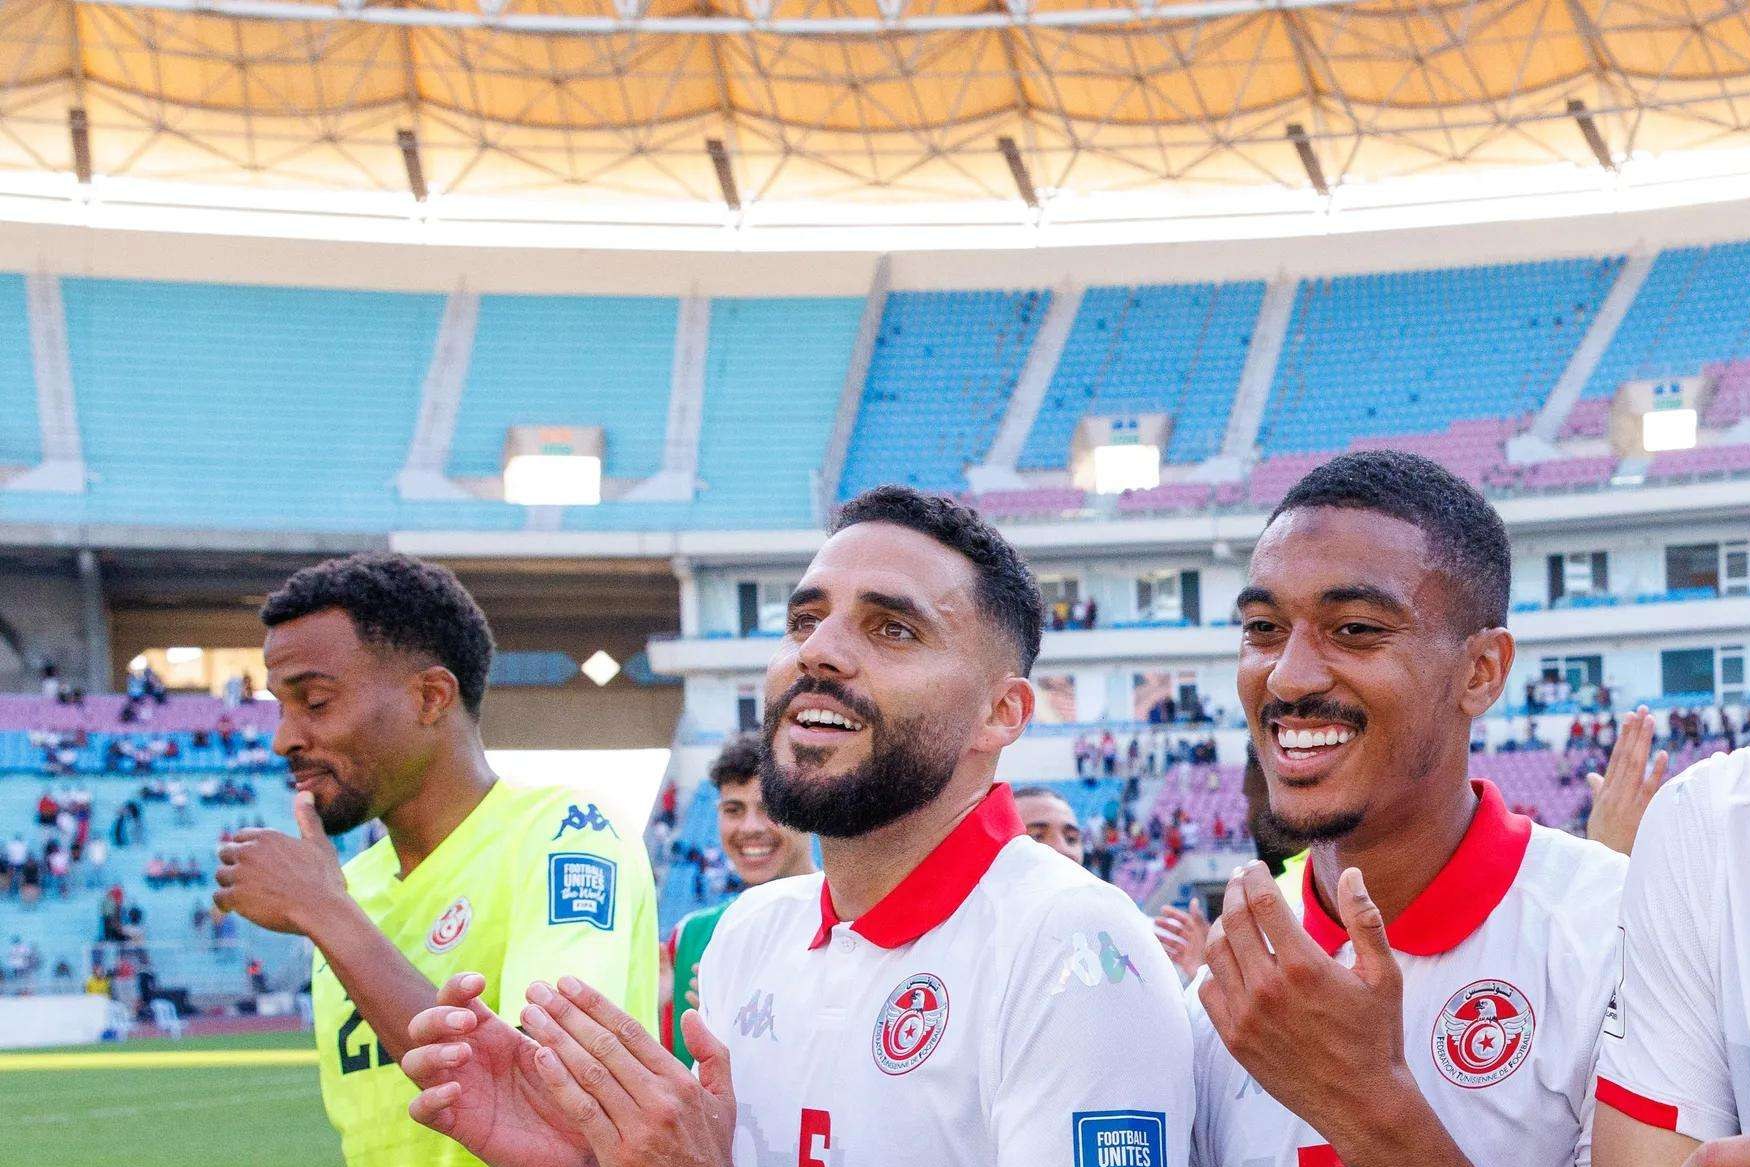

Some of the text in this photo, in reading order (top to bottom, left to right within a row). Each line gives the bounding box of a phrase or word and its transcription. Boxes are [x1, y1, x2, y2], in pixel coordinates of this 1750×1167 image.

[1499, 1066, 1509, 1075] DE
[1097, 1130, 1149, 1146] FOOTBALL
[1098, 1146, 1151, 1167] UNITES
